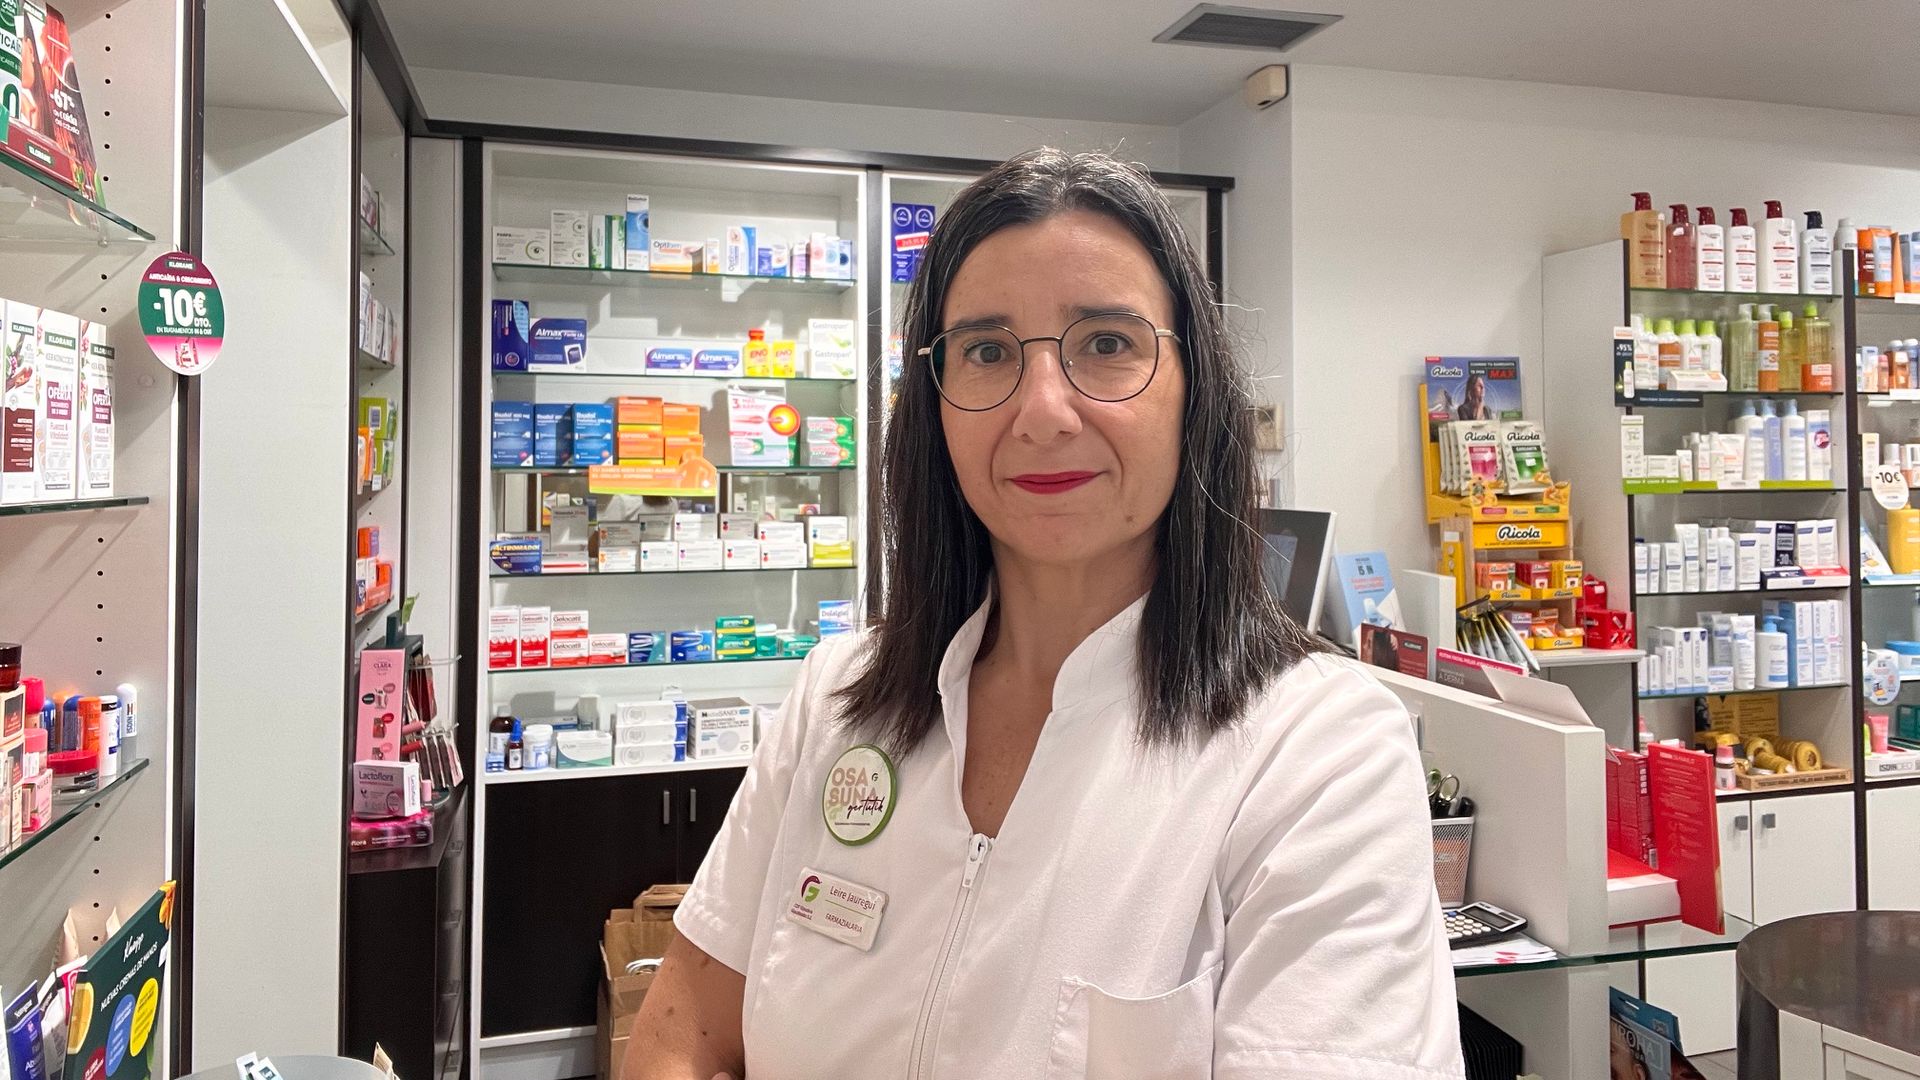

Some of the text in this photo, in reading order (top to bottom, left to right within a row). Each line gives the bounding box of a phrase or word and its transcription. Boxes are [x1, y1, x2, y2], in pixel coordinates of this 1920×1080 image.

[194, 317, 212, 328] DTO.
[1432, 366, 1463, 377] Ricola
[1464, 431, 1496, 442] Ricola
[1507, 432, 1540, 441] Ricola
[1498, 526, 1541, 539] Ricola
[553, 615, 582, 623] Gelocatil
[553, 642, 582, 650] Gelocatil
[359, 770, 394, 782] Lactoflora
[831, 767, 869, 787] OSA
[830, 885, 877, 911] Leire Jauregui
